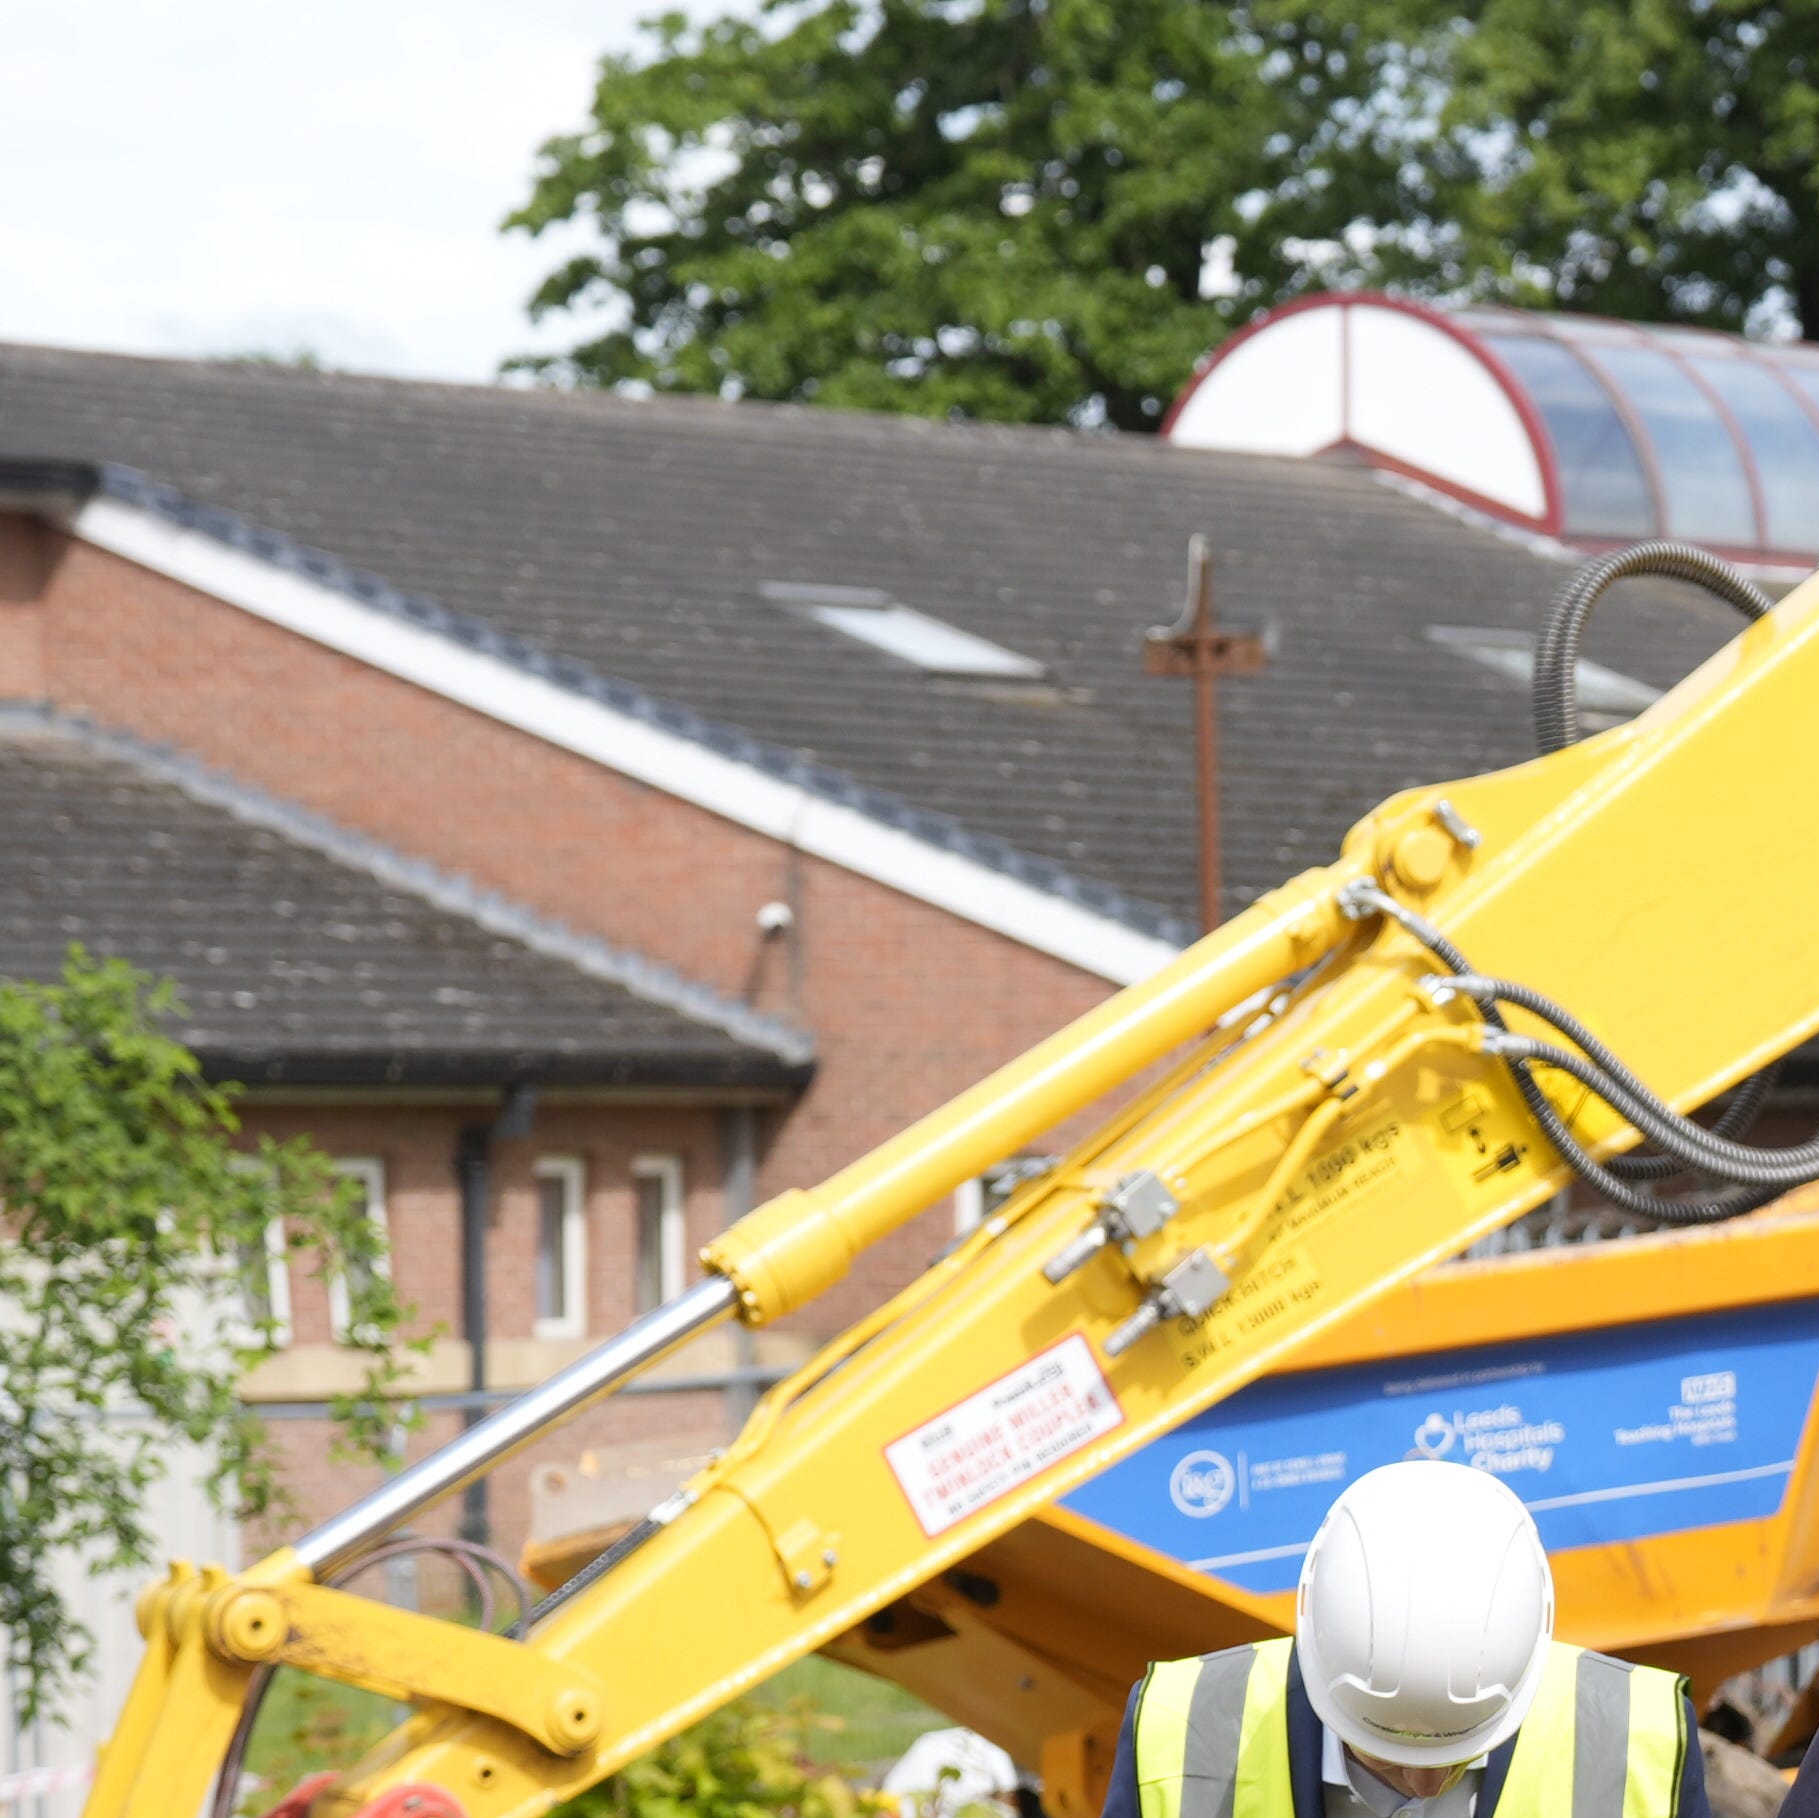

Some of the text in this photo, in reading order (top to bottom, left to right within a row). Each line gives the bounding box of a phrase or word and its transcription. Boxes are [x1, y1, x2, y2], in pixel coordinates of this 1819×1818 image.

[1453, 1404, 1521, 1433] Leeds
[1464, 1422, 1565, 1454] Hospitals
[1470, 1447, 1553, 1473] Charity
